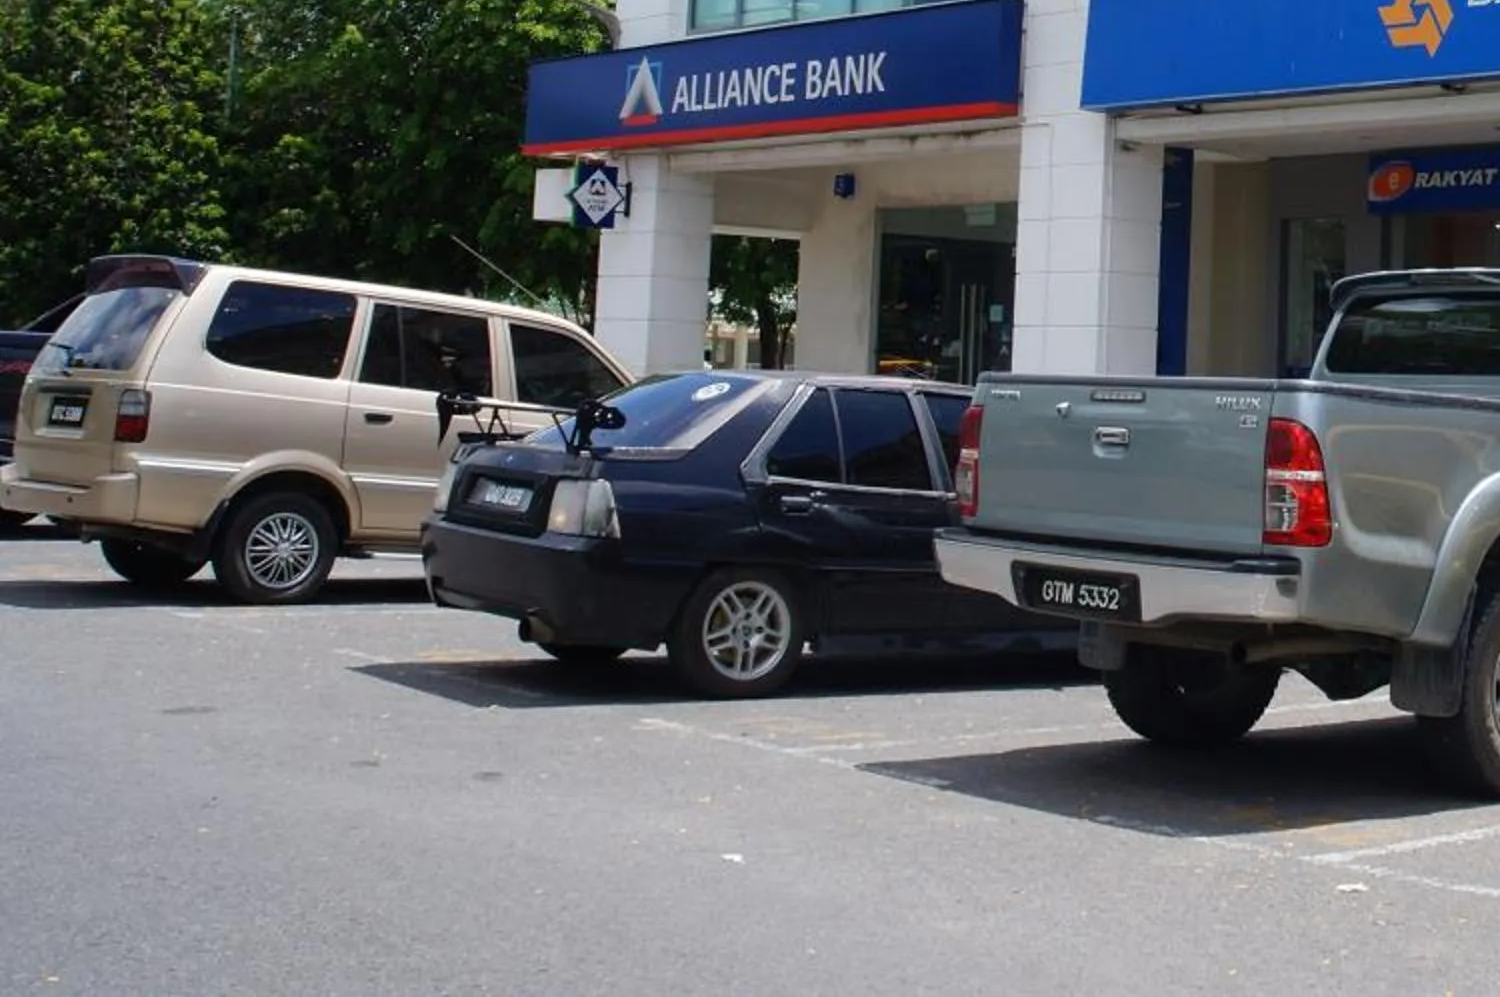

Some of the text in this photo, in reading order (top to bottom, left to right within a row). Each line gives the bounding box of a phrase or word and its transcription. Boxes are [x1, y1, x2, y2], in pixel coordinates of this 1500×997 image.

[671, 51, 888, 114] ALLIANCE BANK
[1413, 167, 1499, 189] RAKYAT
[1078, 584, 1120, 610] 5332
